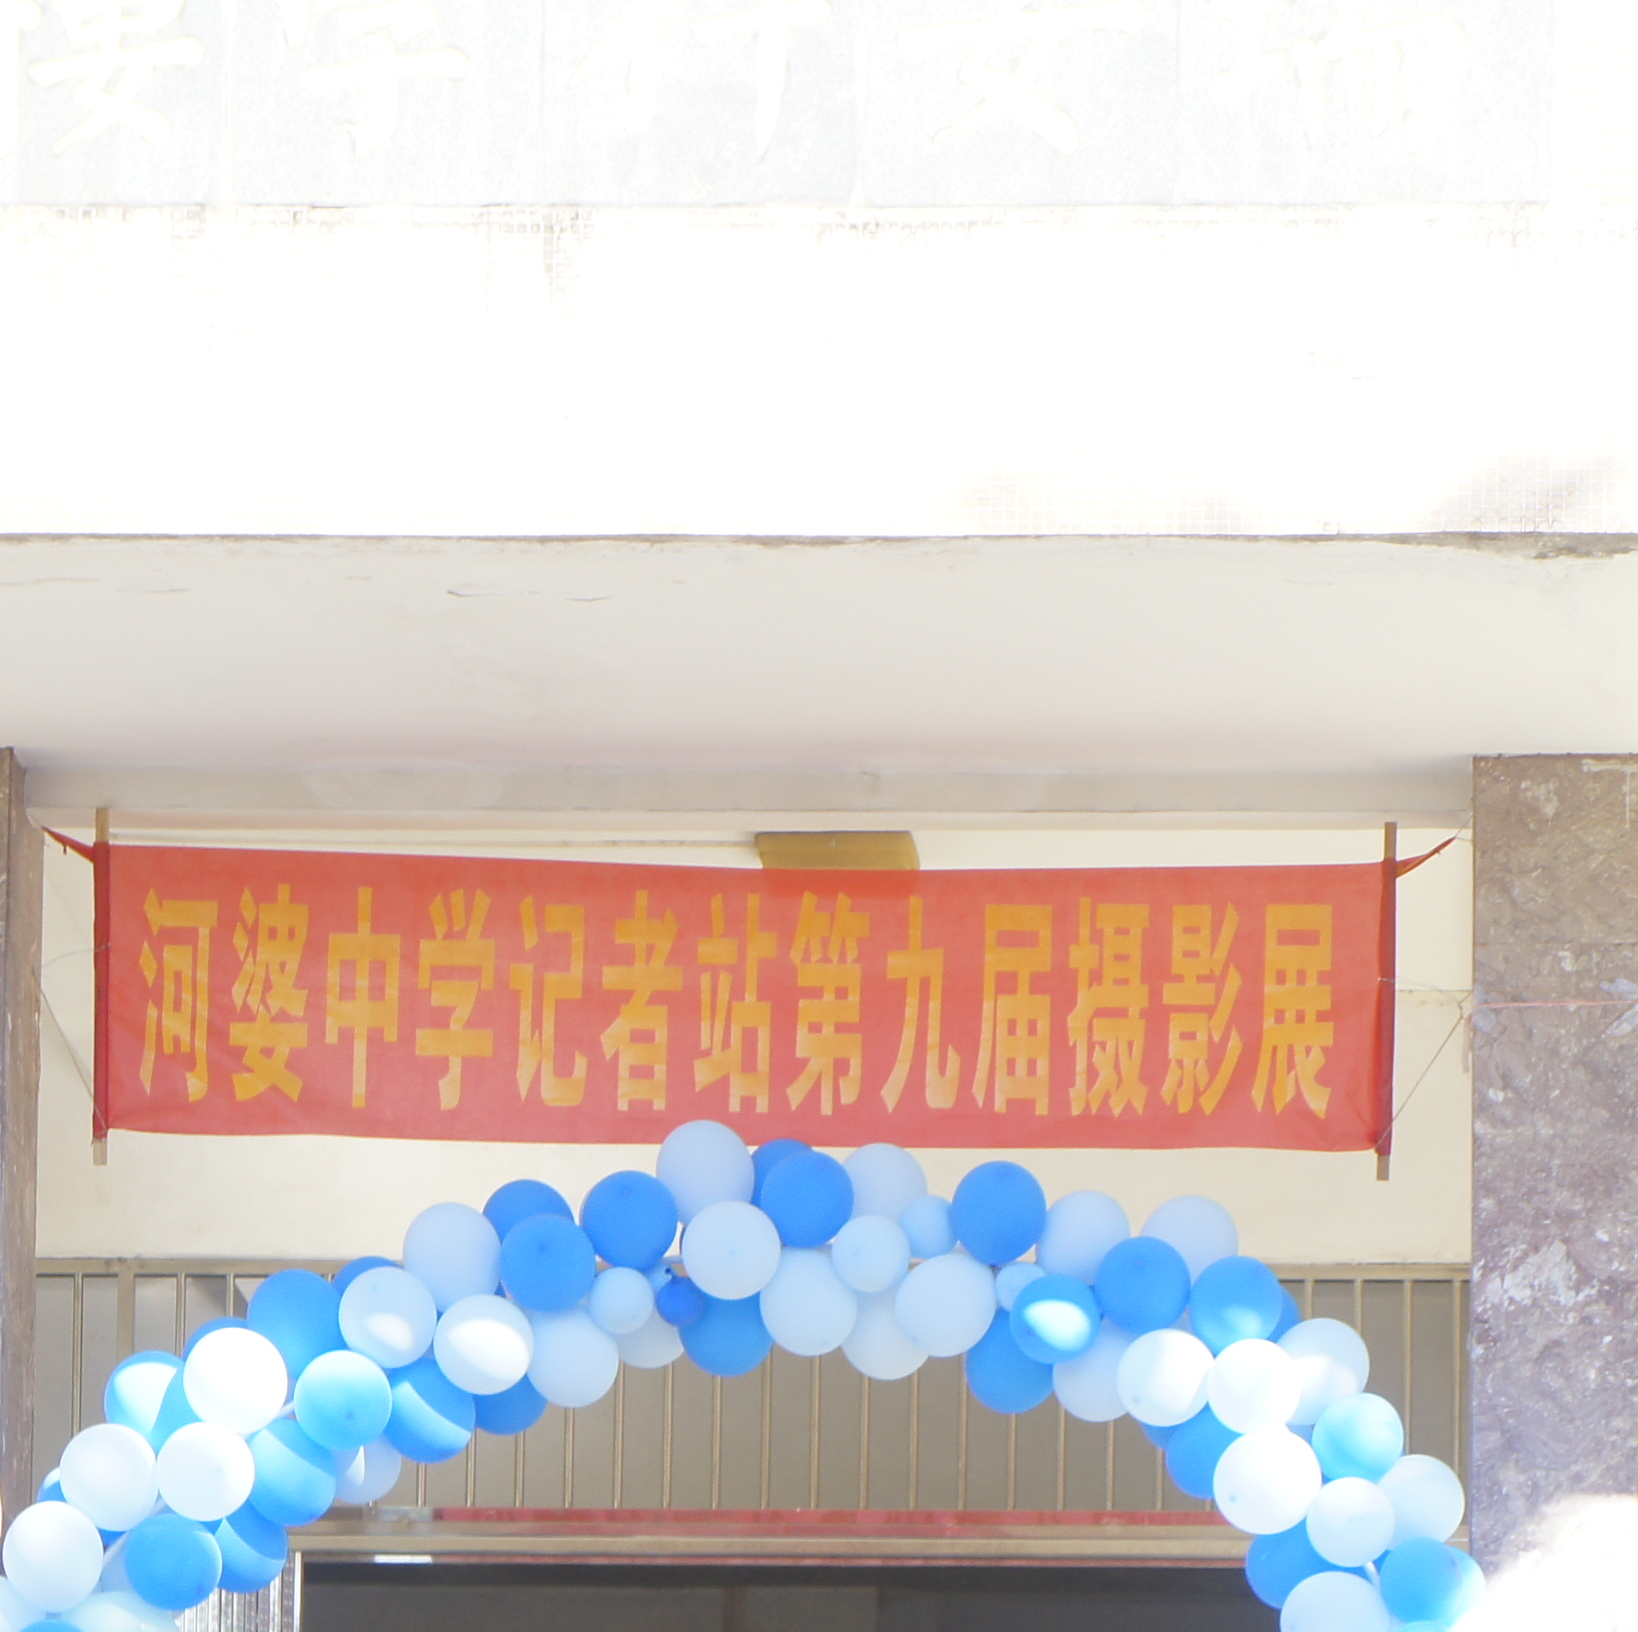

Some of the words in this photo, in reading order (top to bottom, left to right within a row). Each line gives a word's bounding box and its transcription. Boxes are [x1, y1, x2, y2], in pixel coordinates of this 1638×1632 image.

[136, 882, 1335, 1119] 河婆中学记者站第九届摄影展
